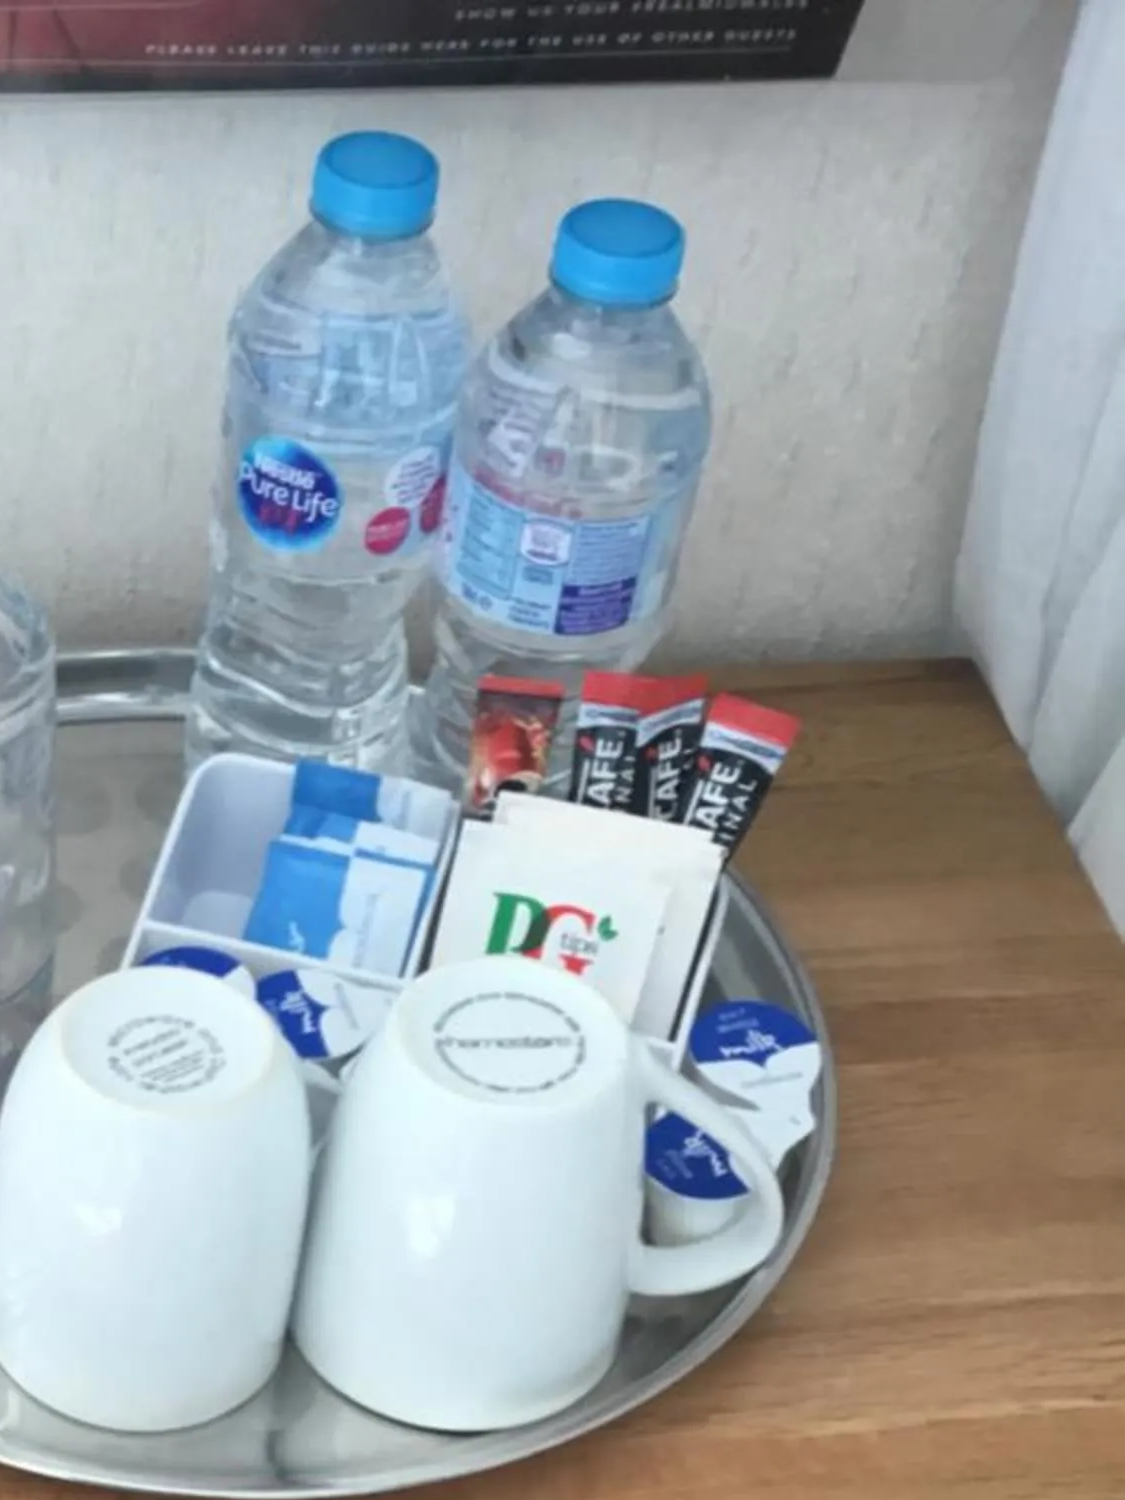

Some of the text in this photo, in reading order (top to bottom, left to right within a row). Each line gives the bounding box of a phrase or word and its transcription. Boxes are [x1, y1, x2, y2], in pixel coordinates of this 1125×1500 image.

[564, 2, 619, 16] YOUR
[145, 28, 797, 56] PLEASE LEAVE THIS GUIDE HERE FOR THE USE OF OTHER GUESTS
[292, 489, 339, 523] Life
